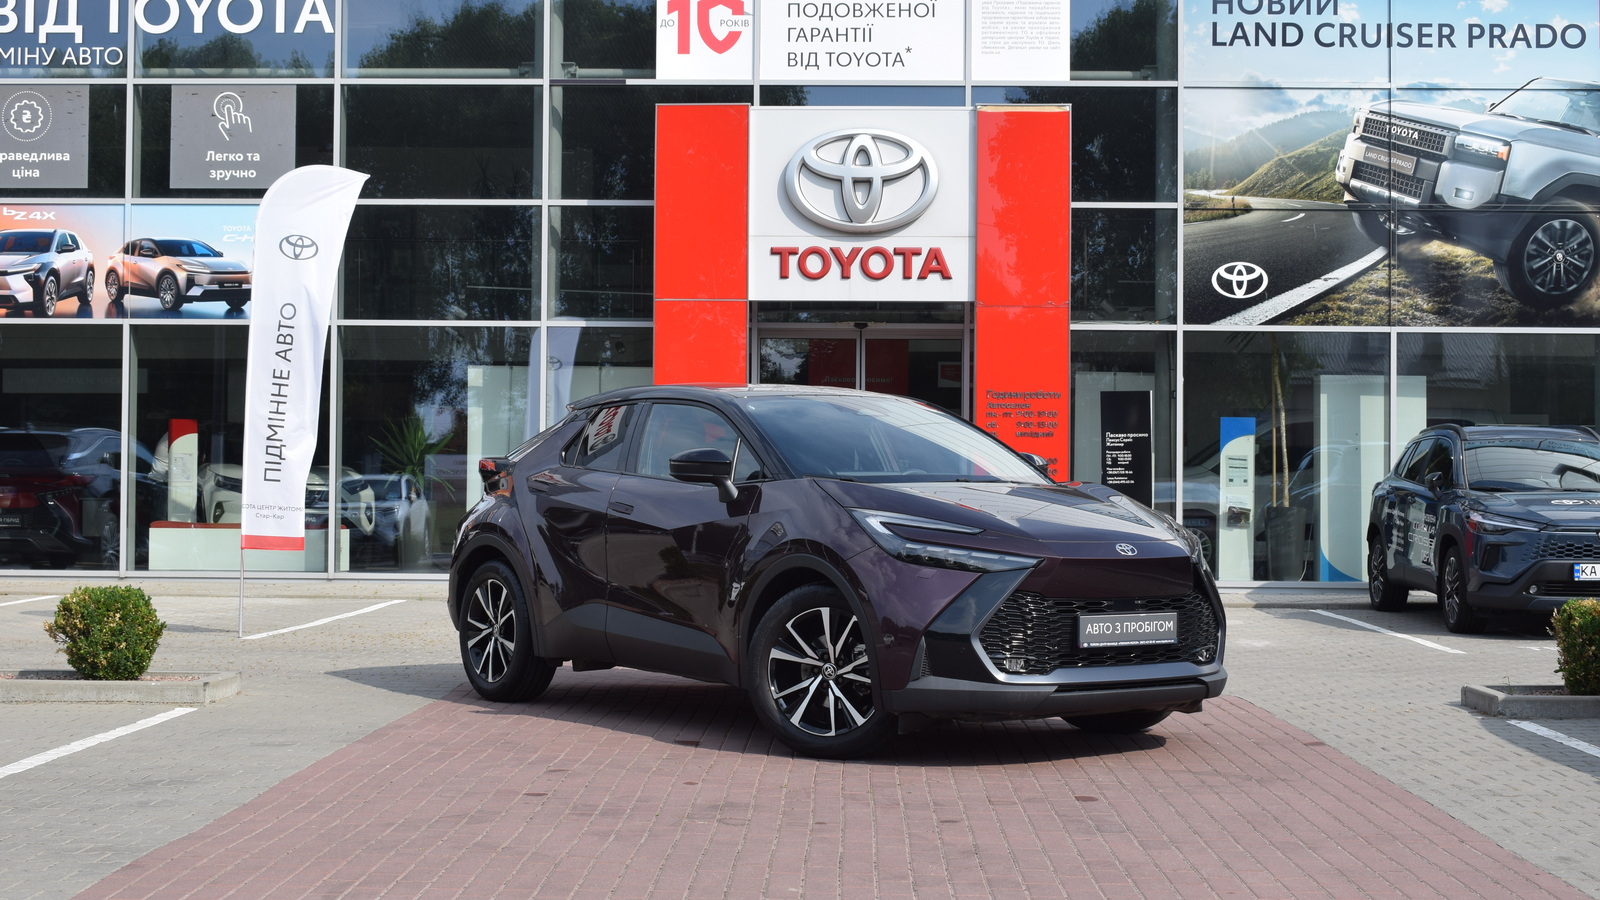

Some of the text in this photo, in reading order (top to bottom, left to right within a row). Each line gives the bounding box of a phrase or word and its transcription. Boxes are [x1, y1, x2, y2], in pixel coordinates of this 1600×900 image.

[787, 0, 936, 21] ПОДОВЖЕНОЇ
[719, 19, 750, 28] РОКІВ
[787, 24, 873, 43] ГАРАНТІЇ
[1212, 21, 1587, 49] LAND CRUISER PRADO
[62, 47, 123, 65] АВТО
[787, 51, 819, 70] ВІД
[1386, 125, 1418, 139] TOYOTA
[205, 151, 261, 163] Легко та
[12, 166, 40, 179] ціна
[209, 169, 257, 181] зручно
[770, 245, 953, 280] TOYOTA
[263, 302, 297, 483] ПІДМІННЕ АВТО
[986, 389, 1061, 400] Години роботи
[255, 512, 285, 520] Стар-Кар
[1085, 620, 1174, 634] АВТО З ПРОБІГОМ
